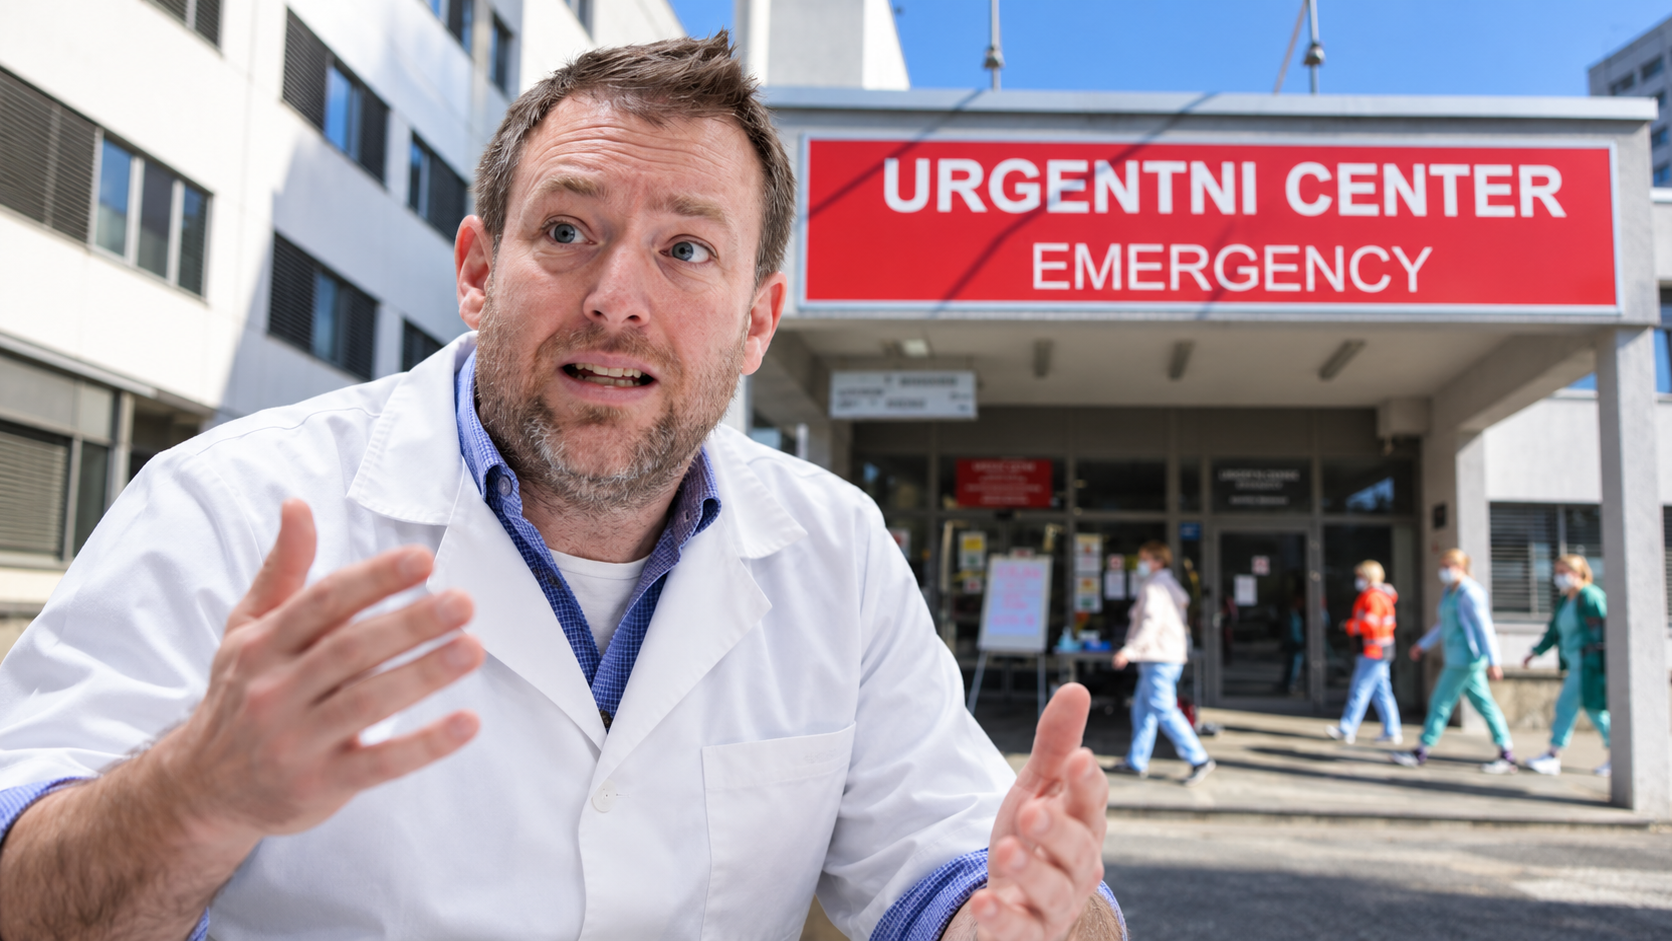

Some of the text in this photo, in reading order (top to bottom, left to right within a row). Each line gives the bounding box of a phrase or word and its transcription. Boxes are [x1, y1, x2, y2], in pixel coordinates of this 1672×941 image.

[884, 158, 1566, 217] URGENTNI CENTER
[1033, 243, 1432, 293] EMERGENCY
